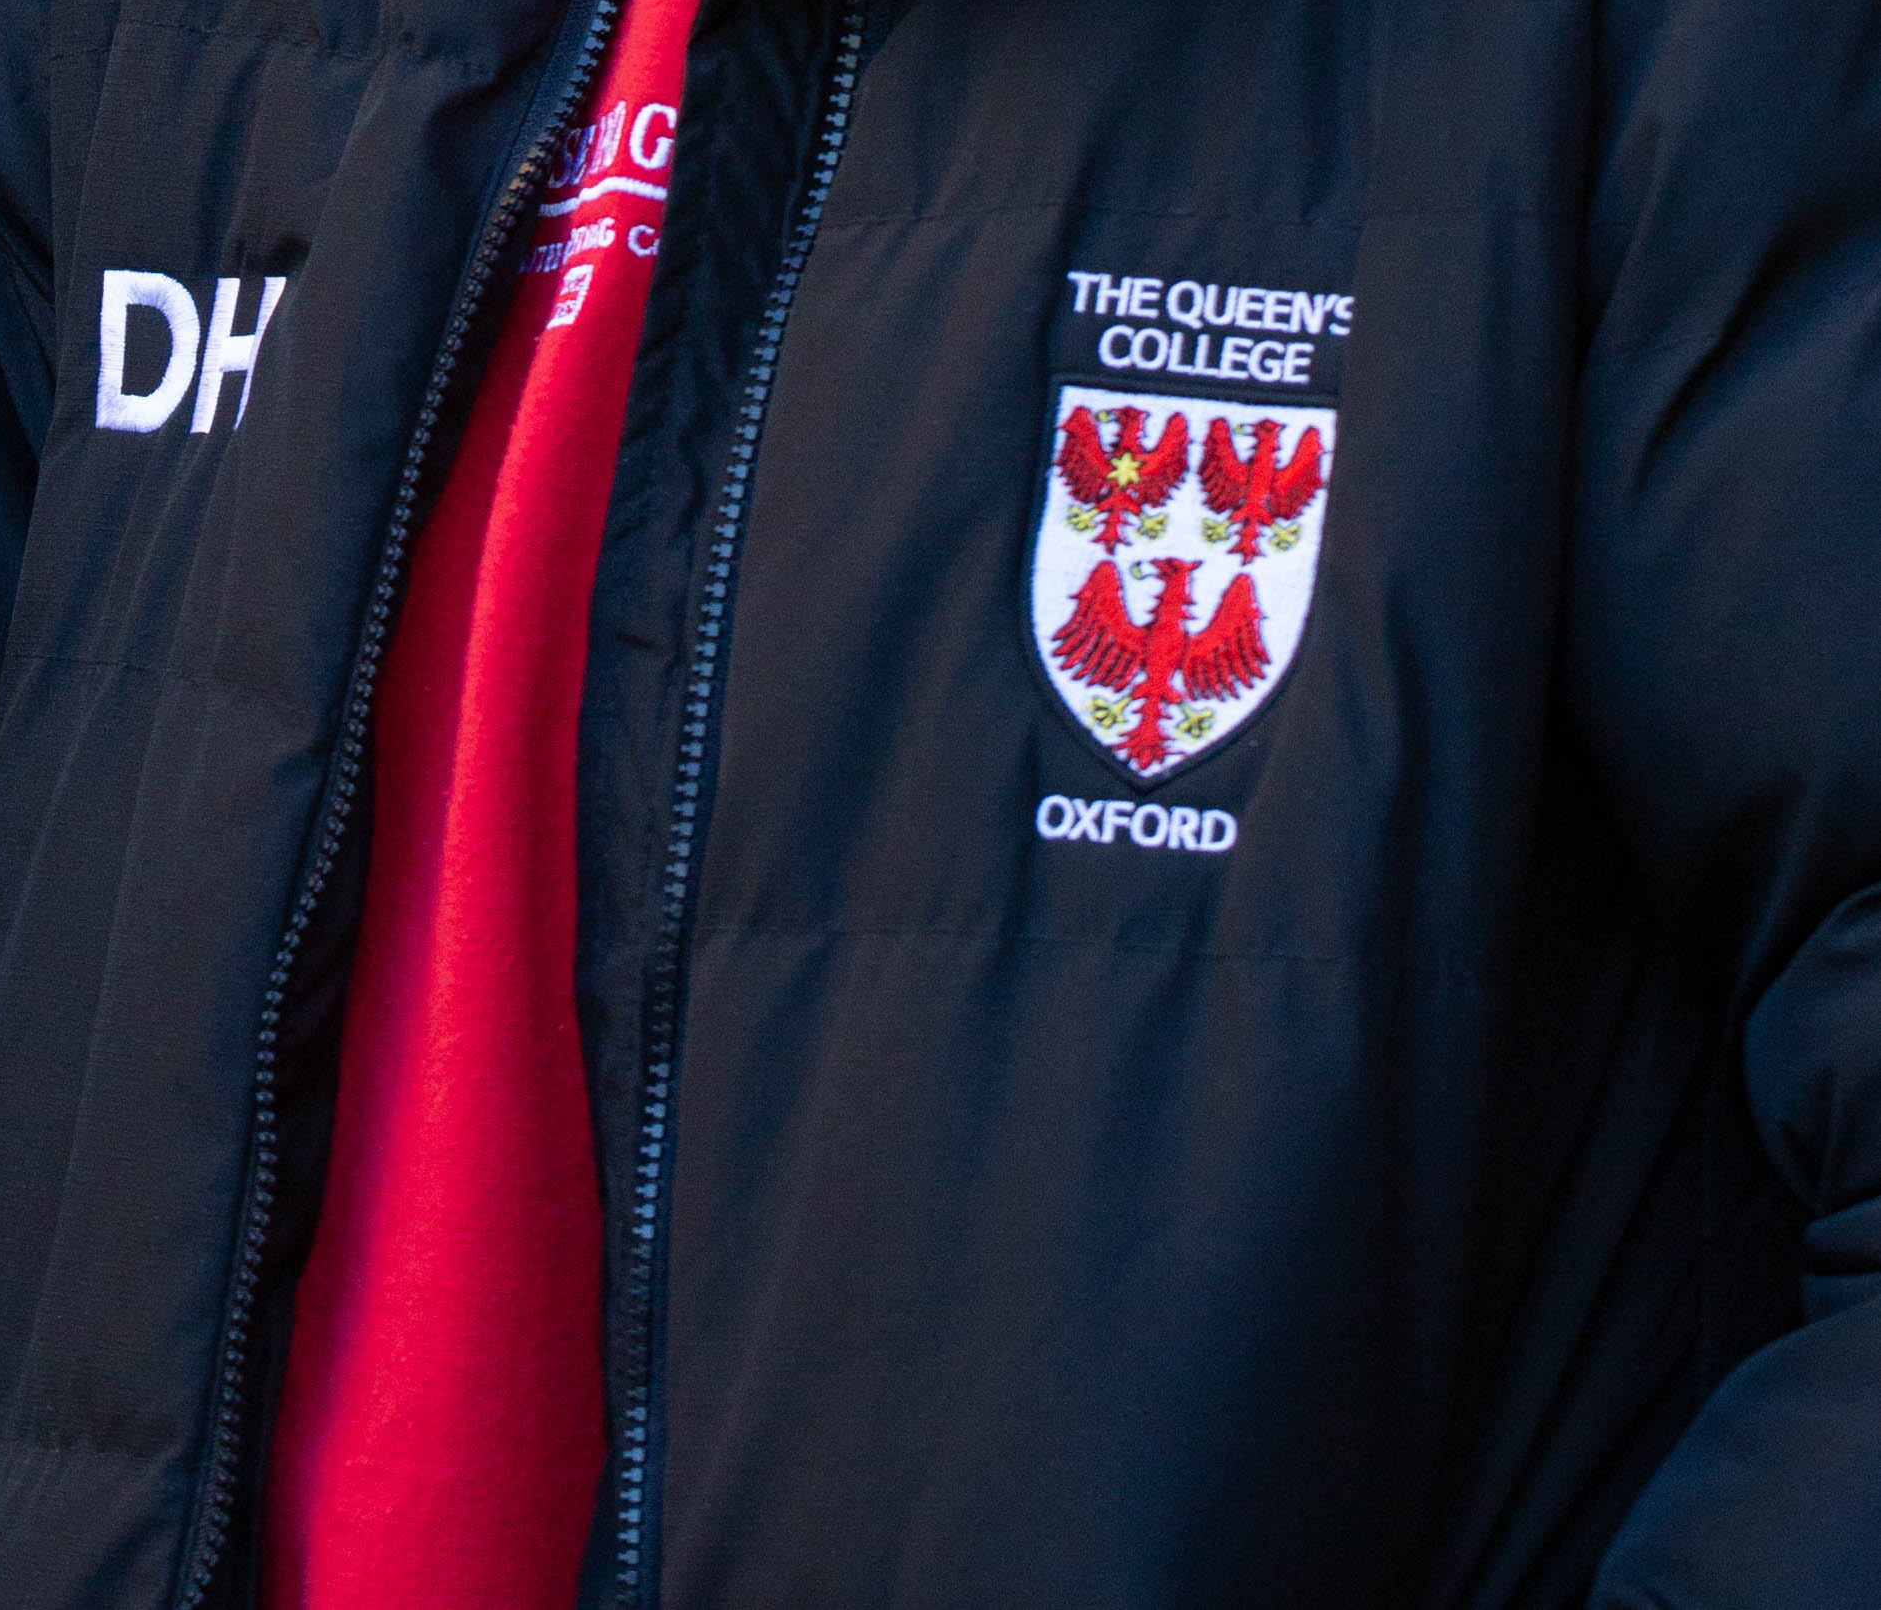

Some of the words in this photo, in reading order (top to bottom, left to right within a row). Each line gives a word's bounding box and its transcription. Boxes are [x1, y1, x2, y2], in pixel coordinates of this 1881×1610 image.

[1067, 270, 1164, 318] THE
[1165, 280, 1356, 336] QUEEN'S
[95, 269, 287, 434] DH
[1098, 324, 1315, 384] COLLEGE
[1035, 793, 1238, 853] OXFORD
